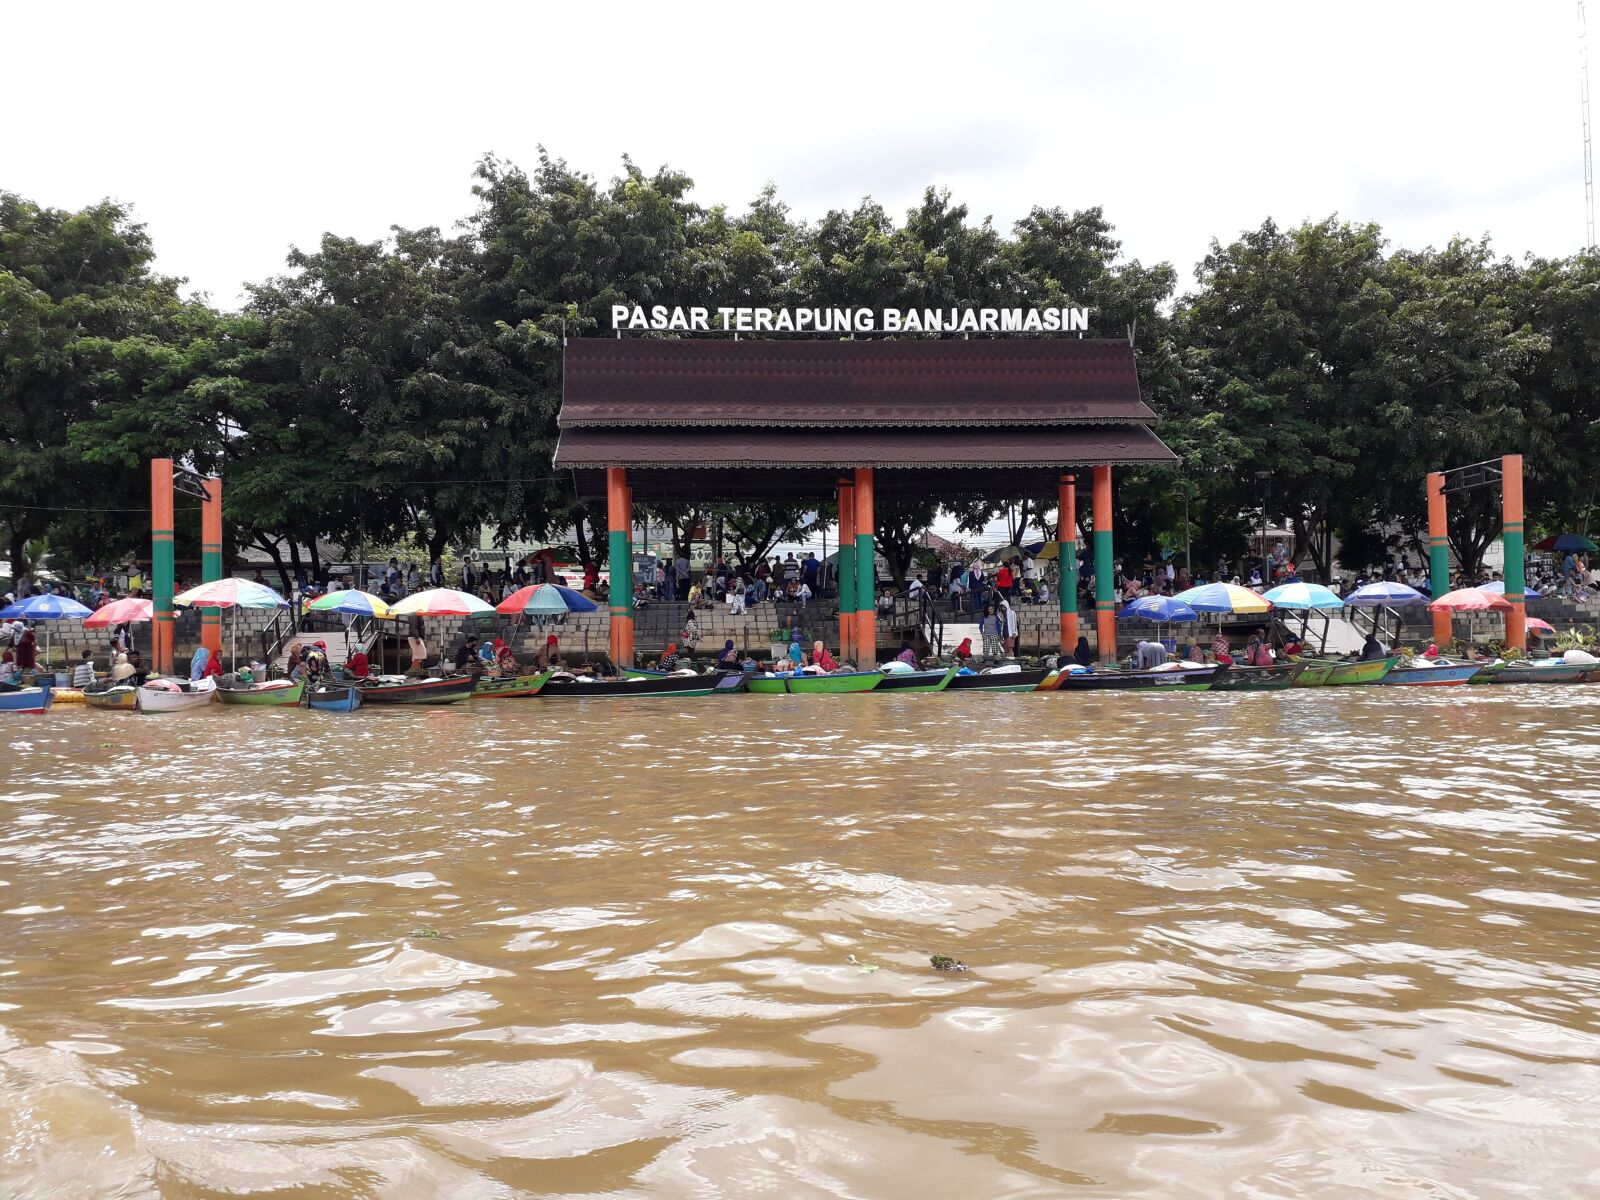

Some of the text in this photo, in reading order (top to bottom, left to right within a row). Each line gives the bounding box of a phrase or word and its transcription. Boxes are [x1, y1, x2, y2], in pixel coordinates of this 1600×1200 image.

[611, 304, 1090, 332] PASAR TERAPUNG BANJARMASIN
